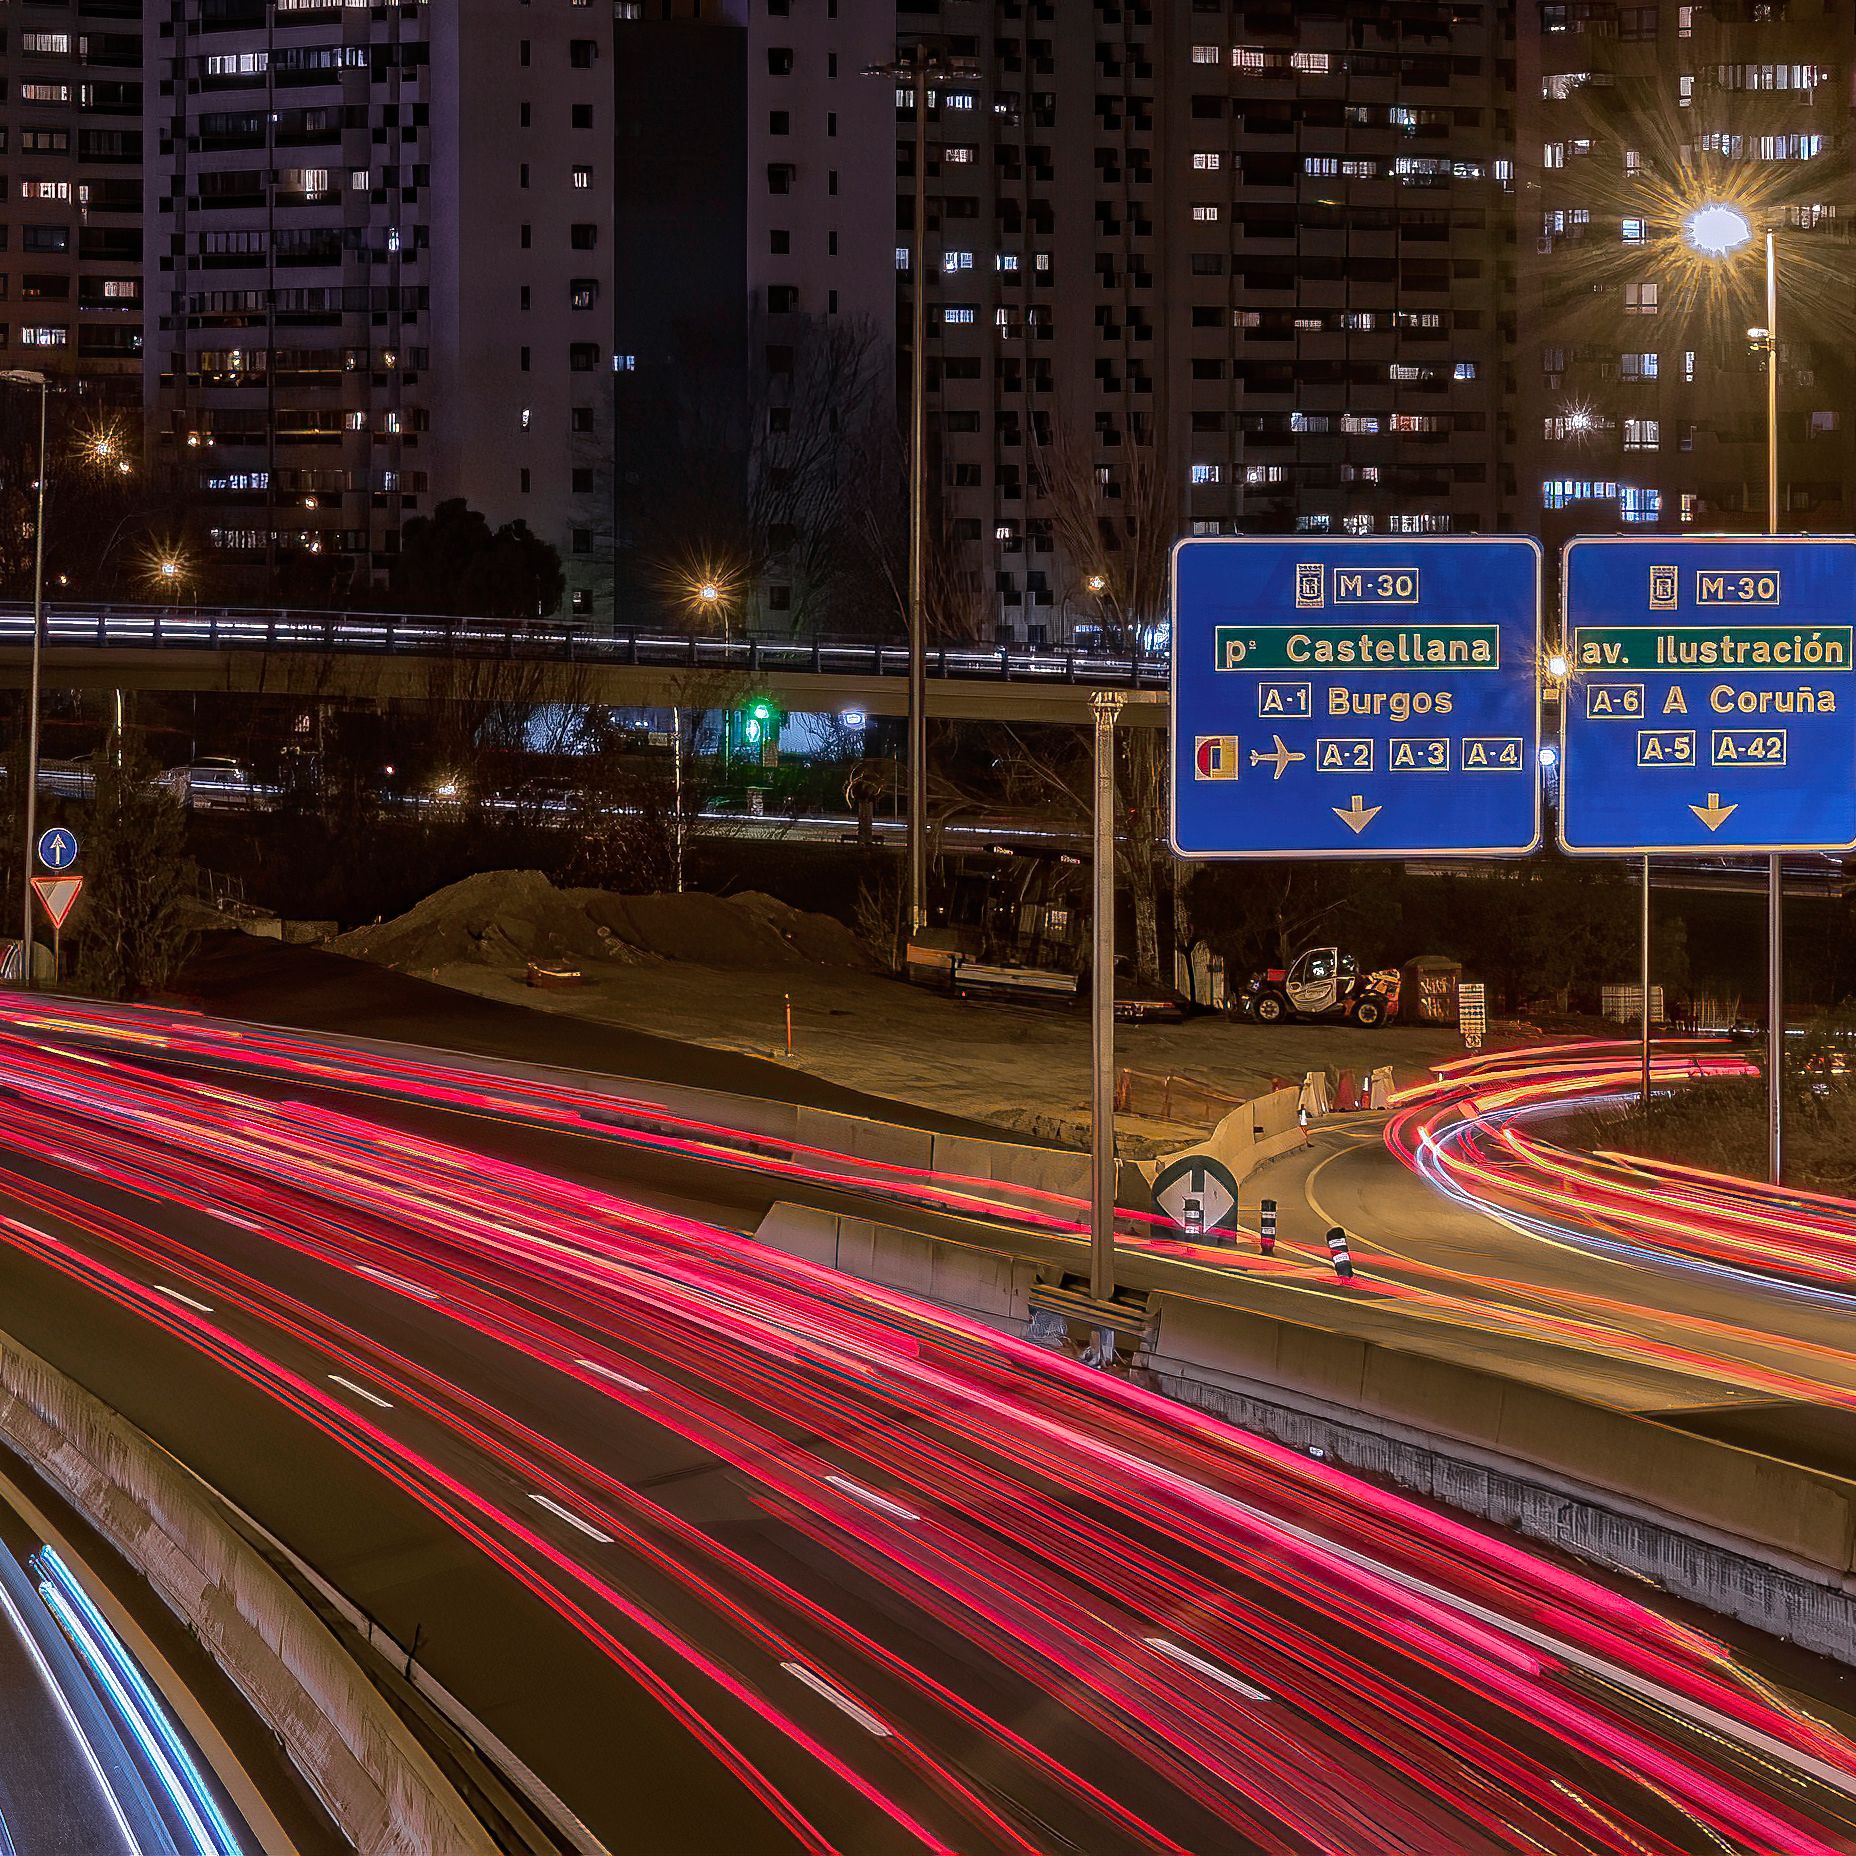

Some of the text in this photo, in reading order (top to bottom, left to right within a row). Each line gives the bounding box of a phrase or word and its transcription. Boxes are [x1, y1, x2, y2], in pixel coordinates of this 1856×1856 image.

[1340, 575, 1413, 597] M-30
[1702, 577, 1775, 600] M-30
[1286, 633, 1491, 662] Castellana
[1582, 632, 1843, 664] av. Ilustración
[1263, 687, 1453, 722] A-1 Burgos
[1592, 684, 1837, 714] A-6 A Coruña
[1322, 742, 1518, 766] A-2 A-3 A-4
[1643, 737, 1782, 760] A-5 A-42
